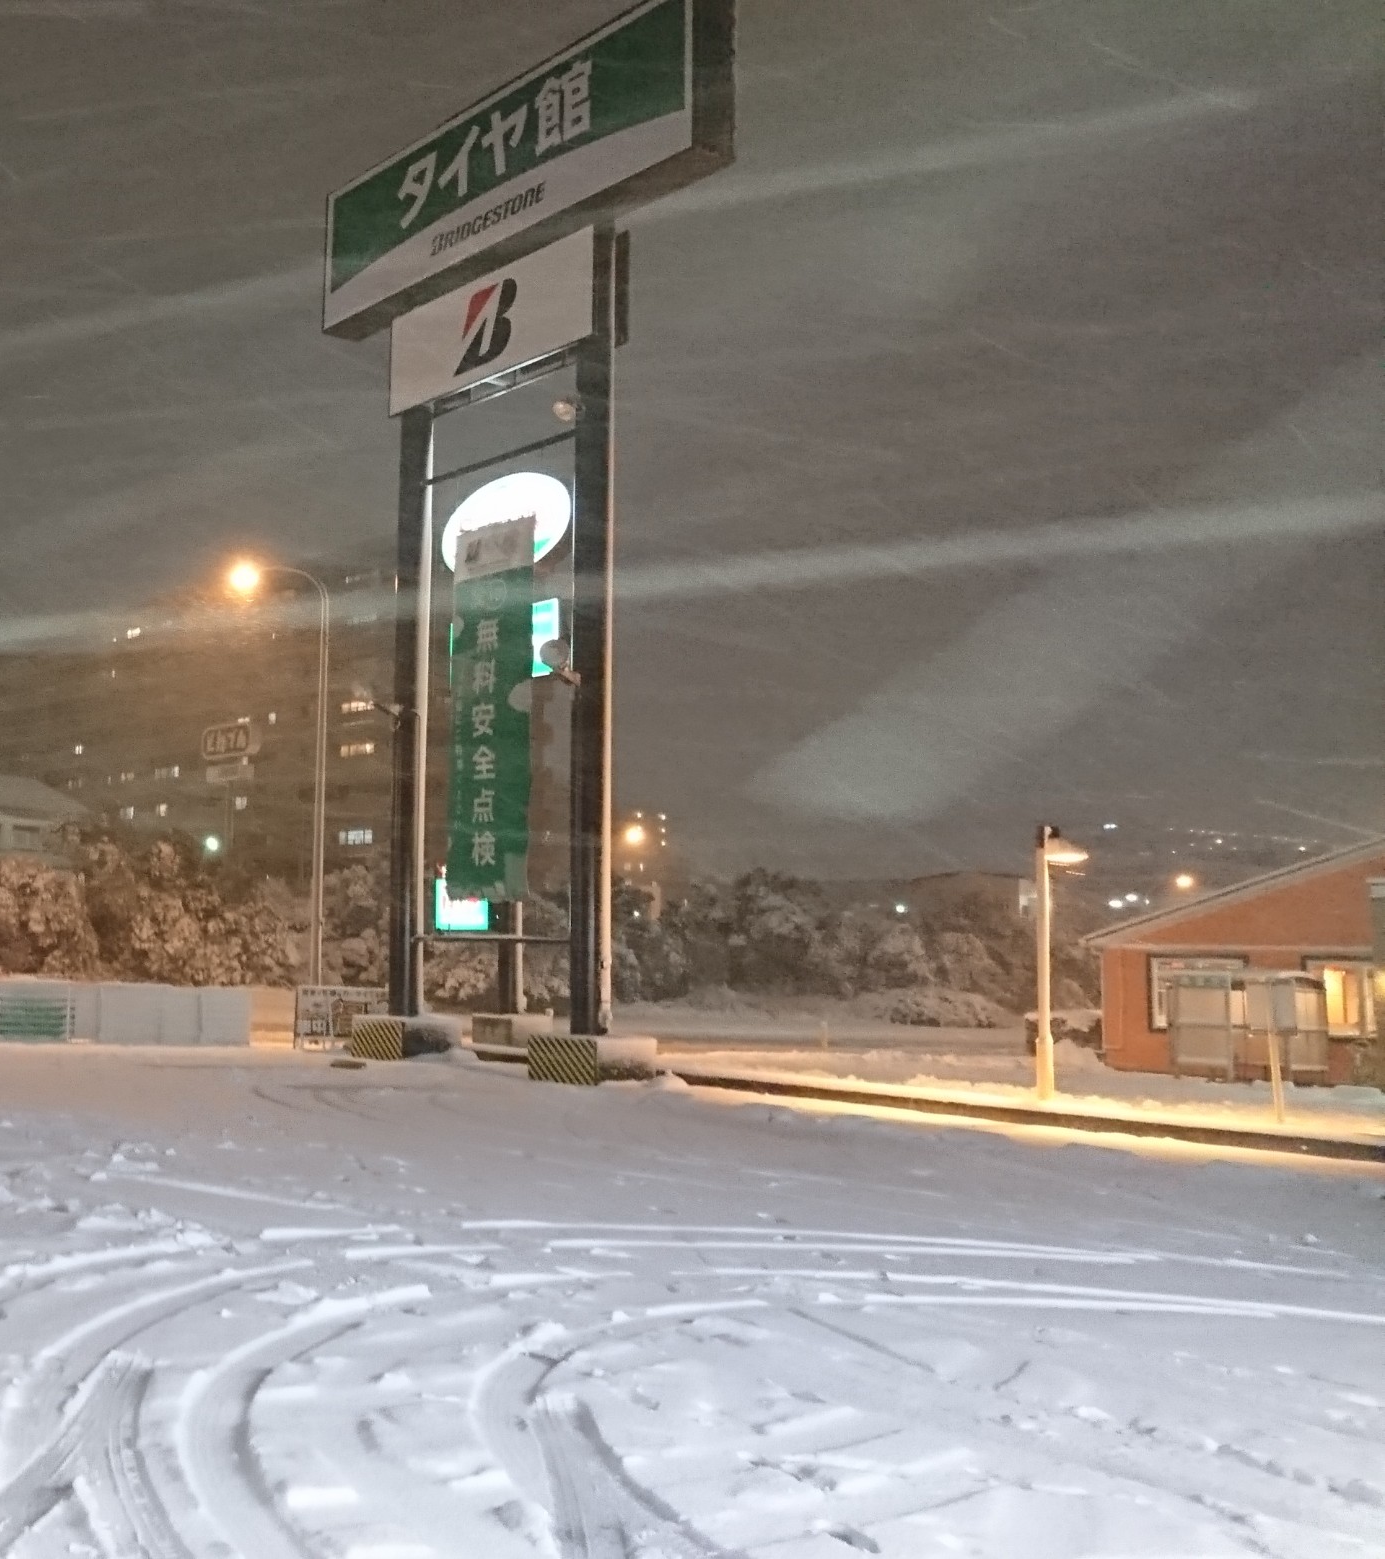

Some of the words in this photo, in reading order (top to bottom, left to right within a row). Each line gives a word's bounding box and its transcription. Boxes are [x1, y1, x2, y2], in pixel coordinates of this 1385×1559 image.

[397, 58, 593, 229] タイヤ館
[430, 181, 546, 256] BRIDGESTONE
[471, 618, 500, 867] 無料安全点検
